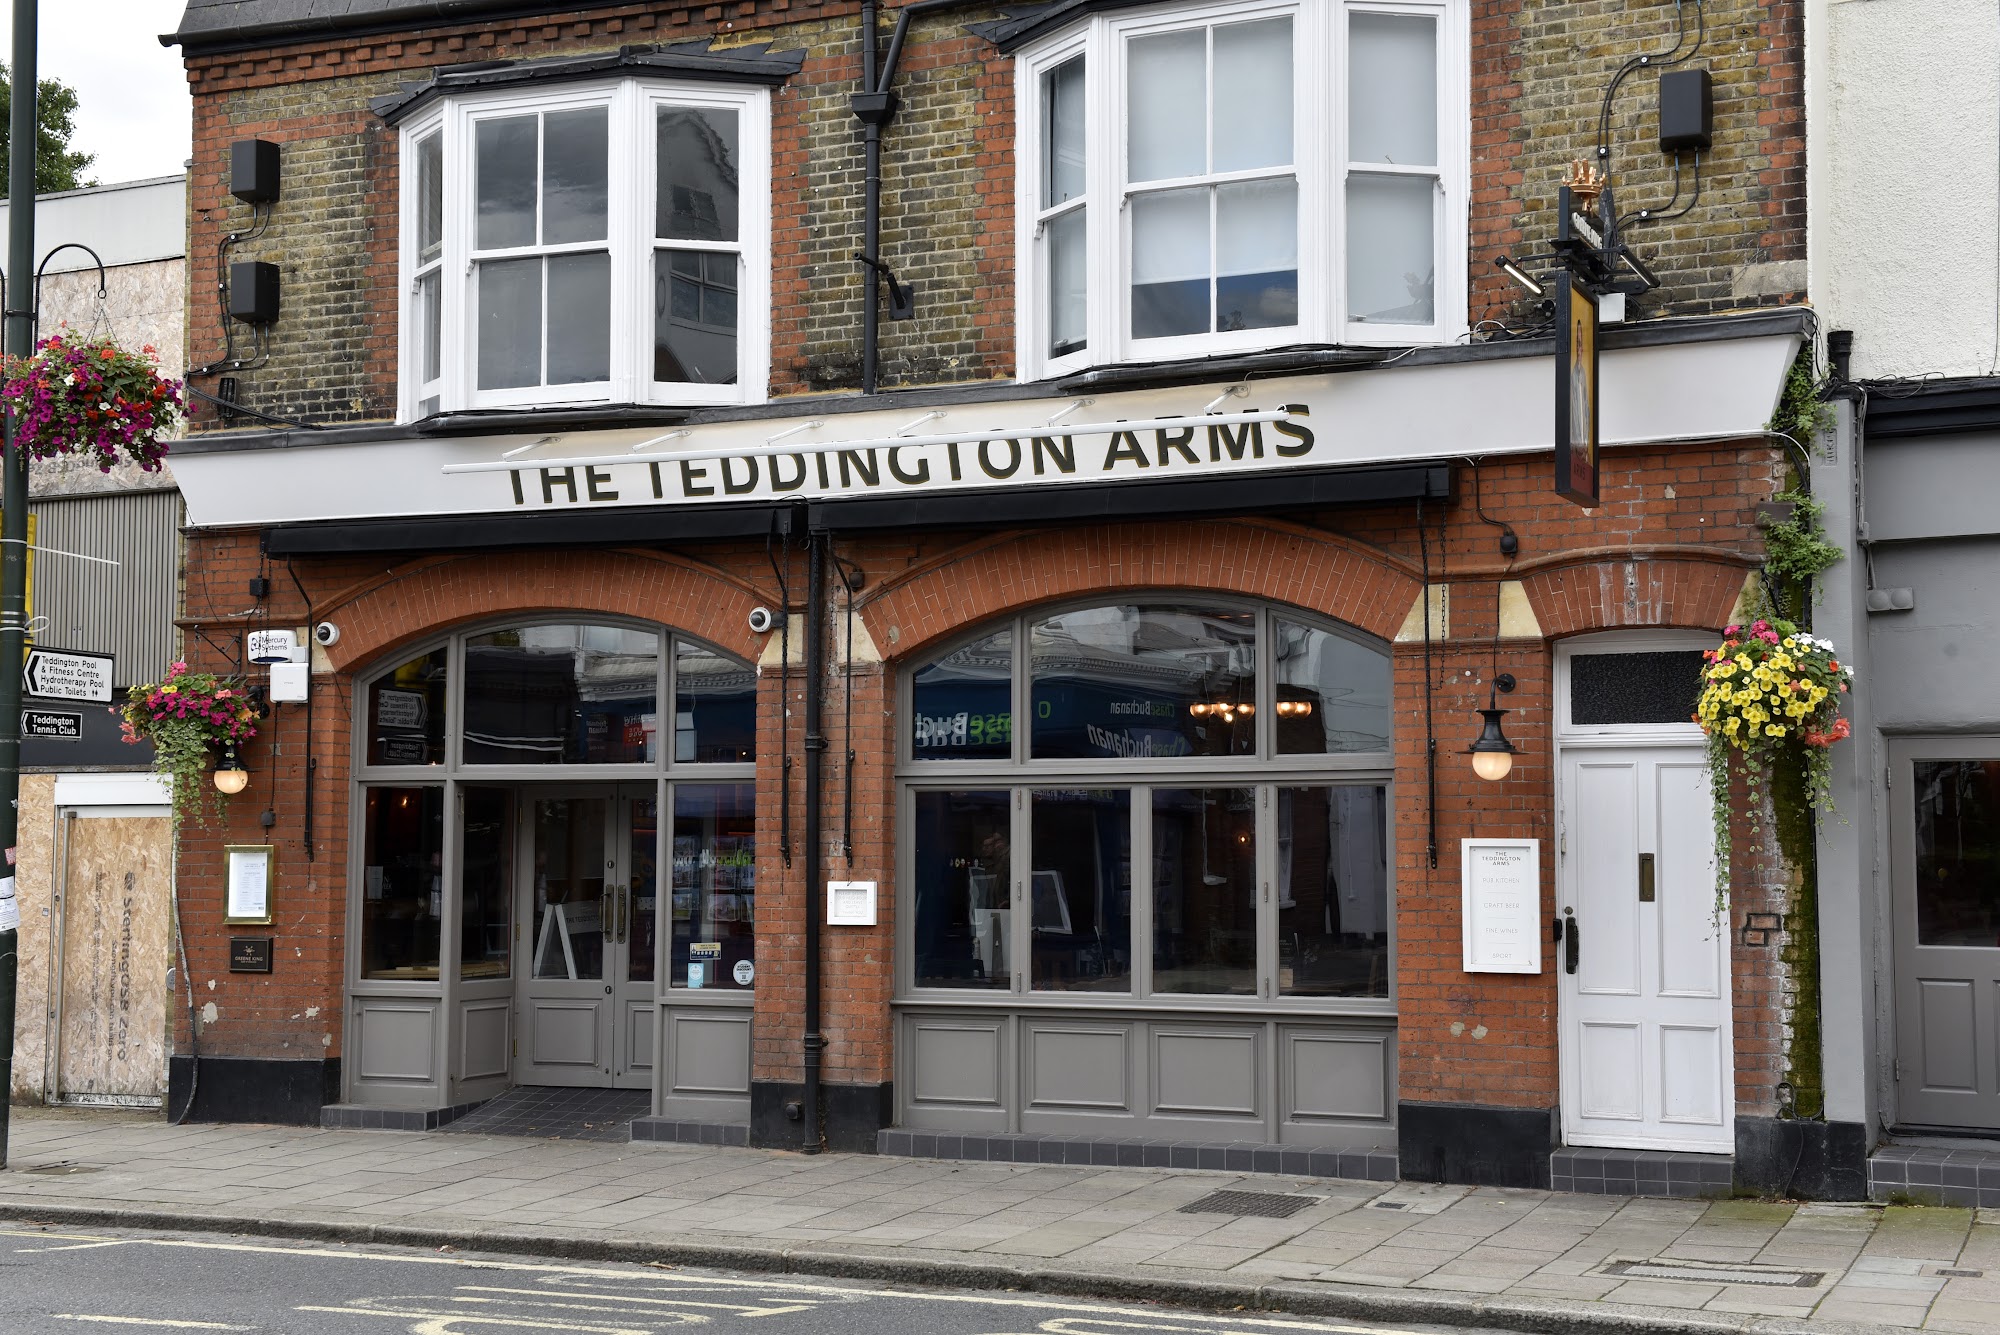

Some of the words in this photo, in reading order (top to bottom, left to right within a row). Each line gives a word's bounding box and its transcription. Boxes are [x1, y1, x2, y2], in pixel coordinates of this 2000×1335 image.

[509, 464, 619, 505] THE
[649, 425, 1076, 499] TEDDINGTON
[1102, 404, 1315, 471] ARMS
[42, 656, 79, 667] Teddington
[82, 660, 97, 669] Pool
[49, 666, 74, 676] Fitness
[77, 669, 100, 678] Centre
[40, 675, 87, 687] Hydrotherapy
[90, 680, 104, 688] Pool
[40, 685, 62, 694] Public
[65, 687, 87, 696] Toilets
[32, 715, 74, 726] Teddington
[32, 725, 57, 734] Tennis
[59, 726, 76, 735] Club
